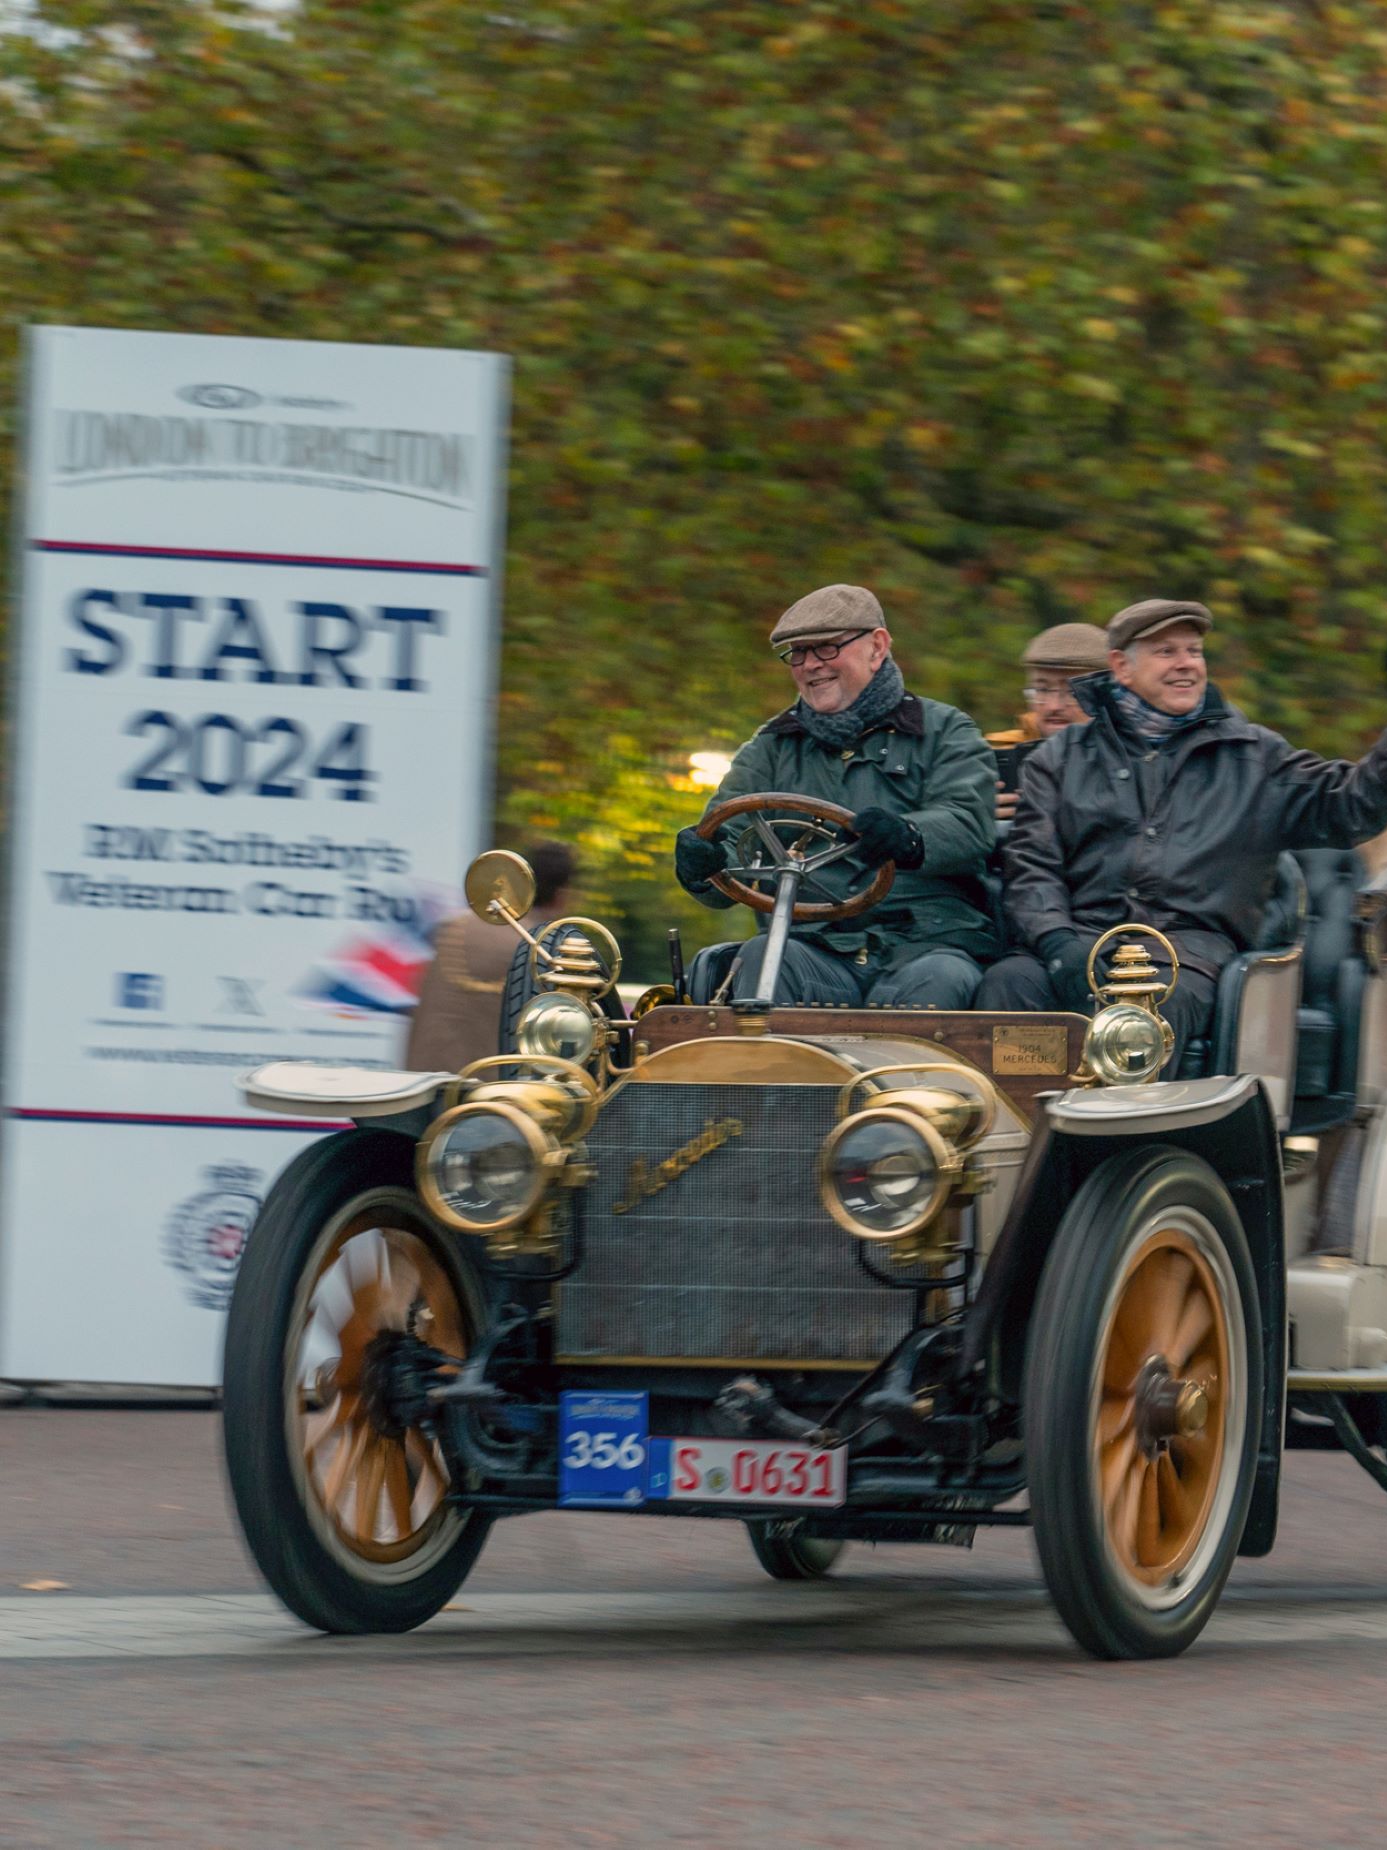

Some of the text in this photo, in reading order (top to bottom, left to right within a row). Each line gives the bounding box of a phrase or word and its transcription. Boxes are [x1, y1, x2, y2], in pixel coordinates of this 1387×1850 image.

[65, 588, 446, 692] START
[122, 709, 378, 801] 2024
[181, 828, 409, 881] Sotheby's
[44, 871, 238, 914] Veteran
[245, 881, 336, 918] Car
[1003, 1055, 1056, 1064] MERCEDES
[562, 1430, 645, 1470] 356
[674, 1447, 834, 1498] S 0631
